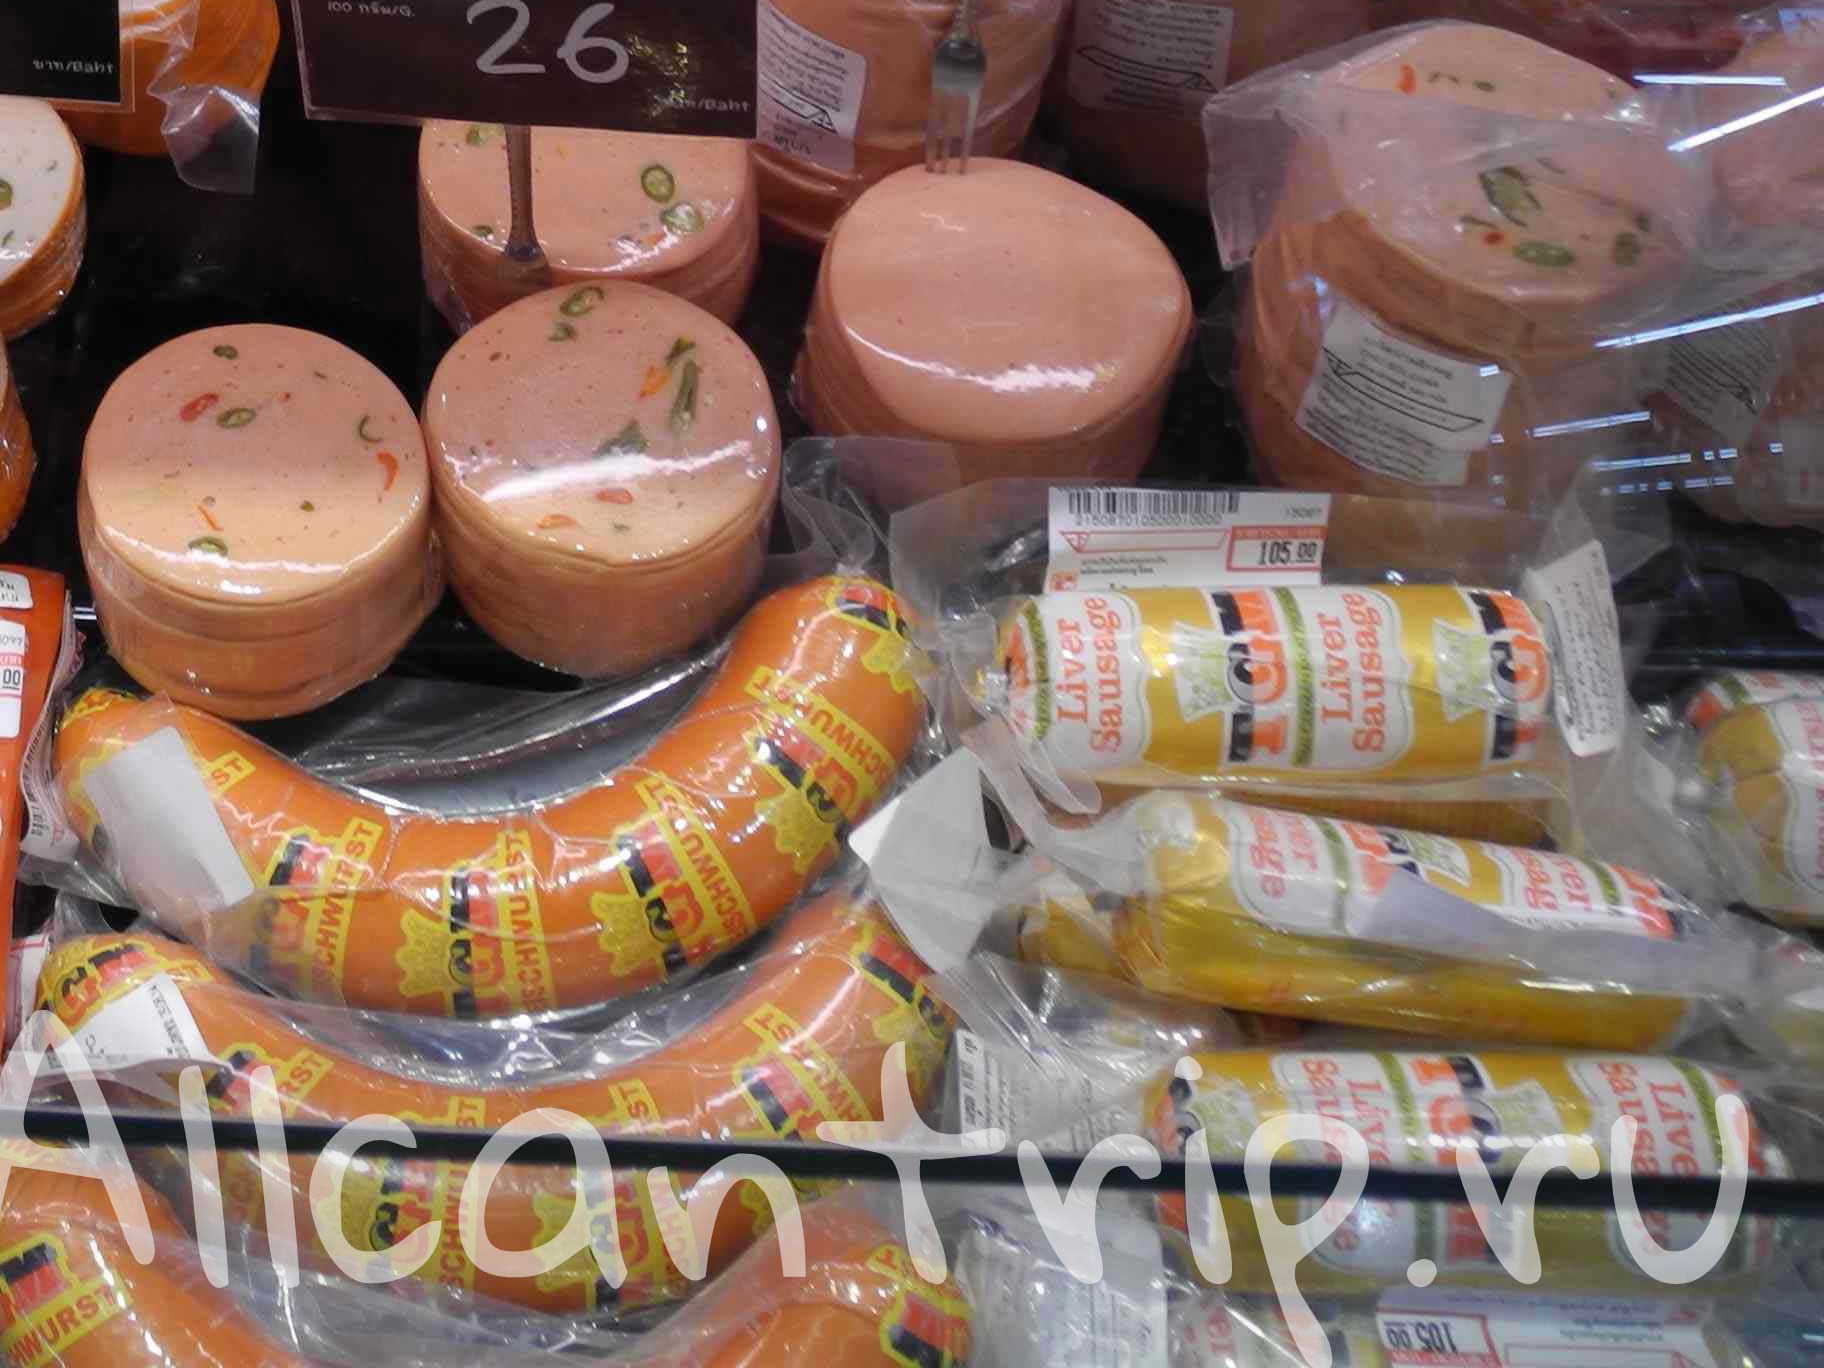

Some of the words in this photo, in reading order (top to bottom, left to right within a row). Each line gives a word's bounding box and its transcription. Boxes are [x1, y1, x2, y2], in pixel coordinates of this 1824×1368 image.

[1258, 540, 1318, 566] 105.00
[1057, 618, 1088, 726] Liver
[1089, 596, 1123, 755] Sausage
[1208, 589, 1290, 763] TGM
[1320, 612, 1352, 726] Liver
[1352, 592, 1384, 755] Sausage
[1467, 589, 1552, 763] TGM
